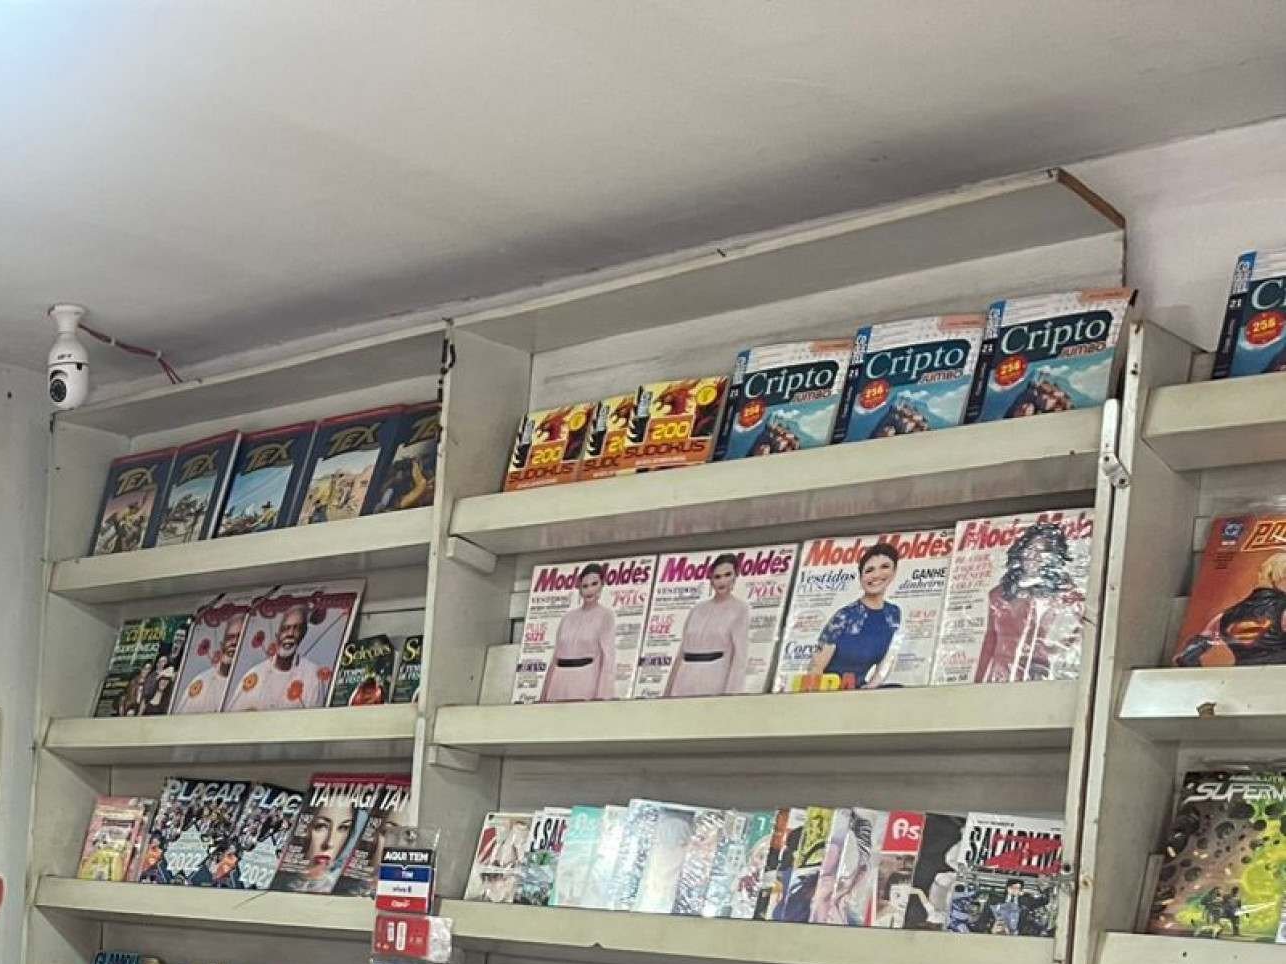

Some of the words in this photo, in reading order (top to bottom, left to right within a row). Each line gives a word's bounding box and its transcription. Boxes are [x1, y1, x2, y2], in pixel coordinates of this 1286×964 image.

[1001, 319, 1106, 355] Cripto
[866, 347, 964, 380] Cripto
[745, 367, 833, 399] Cripto
[331, 422, 382, 455] TEX
[652, 421, 689, 440] 200
[181, 451, 219, 481] TEX
[246, 441, 294, 473] TEX
[115, 466, 157, 496] TEX
